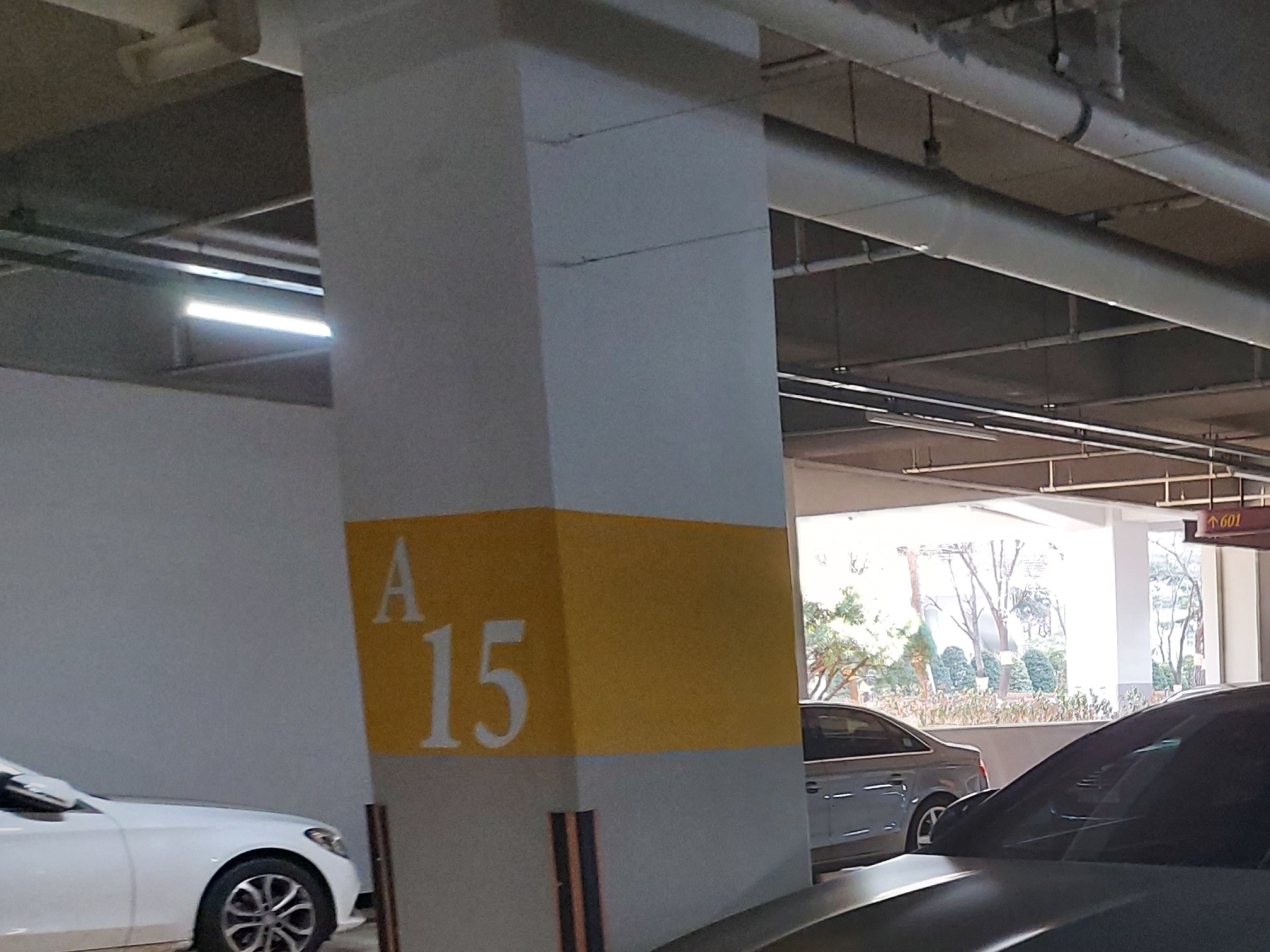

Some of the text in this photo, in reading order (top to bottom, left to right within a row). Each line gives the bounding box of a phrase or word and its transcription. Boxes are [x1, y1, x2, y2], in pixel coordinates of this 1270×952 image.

[1220, 513, 1241, 527] 601
[373, 537, 425, 624] A
[420, 619, 529, 748] 15
